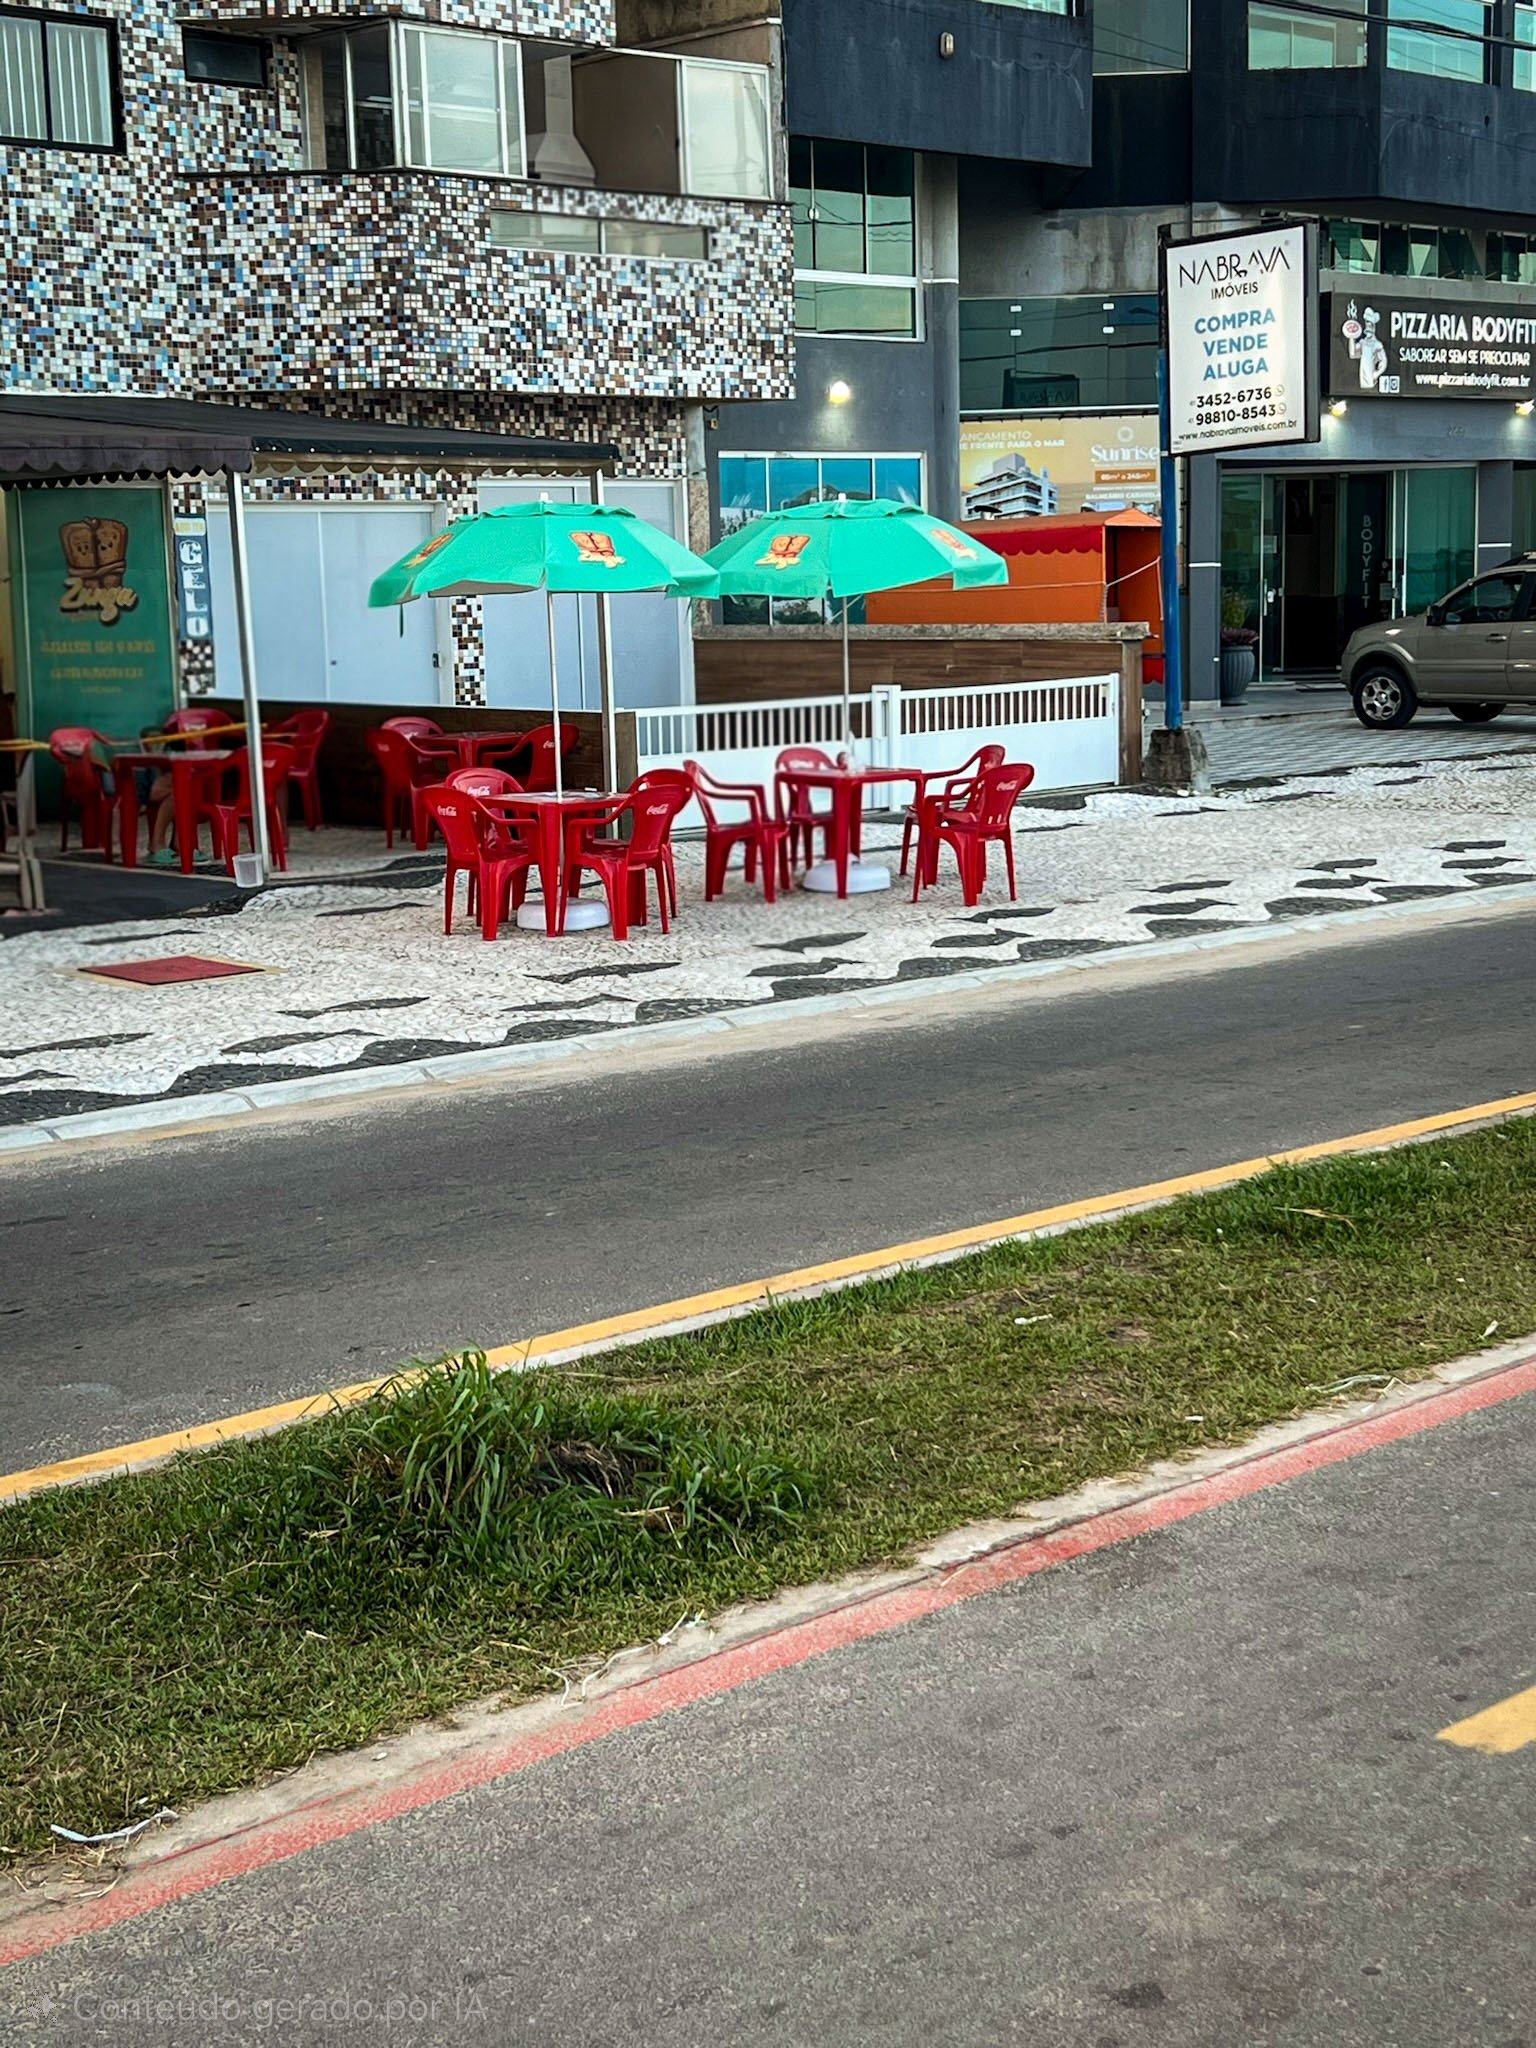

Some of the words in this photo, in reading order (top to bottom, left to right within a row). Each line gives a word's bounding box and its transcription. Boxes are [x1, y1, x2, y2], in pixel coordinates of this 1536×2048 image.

[1211, 281, 1258, 300] IMÓVEIS
[1194, 308, 1276, 334] COMPRA
[1390, 311, 1469, 341] PIZZARIA
[1472, 315, 1536, 345] BODYFIT
[1203, 333, 1268, 357] VENDE
[1399, 347, 1447, 364] SABOREAR
[1448, 348, 1467, 364] SEM
[1468, 349, 1480, 364] SE
[1480, 350, 1530, 366] PREOCUPAR
[1203, 357, 1269, 381] ALUGA
[1415, 372, 1531, 389] www.pizzariabodyfit.com.br
[1196, 387, 1272, 408] 3452-6736
[1196, 404, 1276, 426] 98810-8543
[960, 430, 1032, 441] ANÇAMENTO
[1179, 419, 1297, 441] www.nabravaimoveis.com.br
[1007, 440, 1033, 448] PARA
[1034, 440, 1041, 448] O
[1043, 439, 1065, 447] MAR
[1091, 444, 1160, 462] Sunrise
[1361, 514, 1373, 609] BODYFIT
[180, 540, 209, 637] GELO
